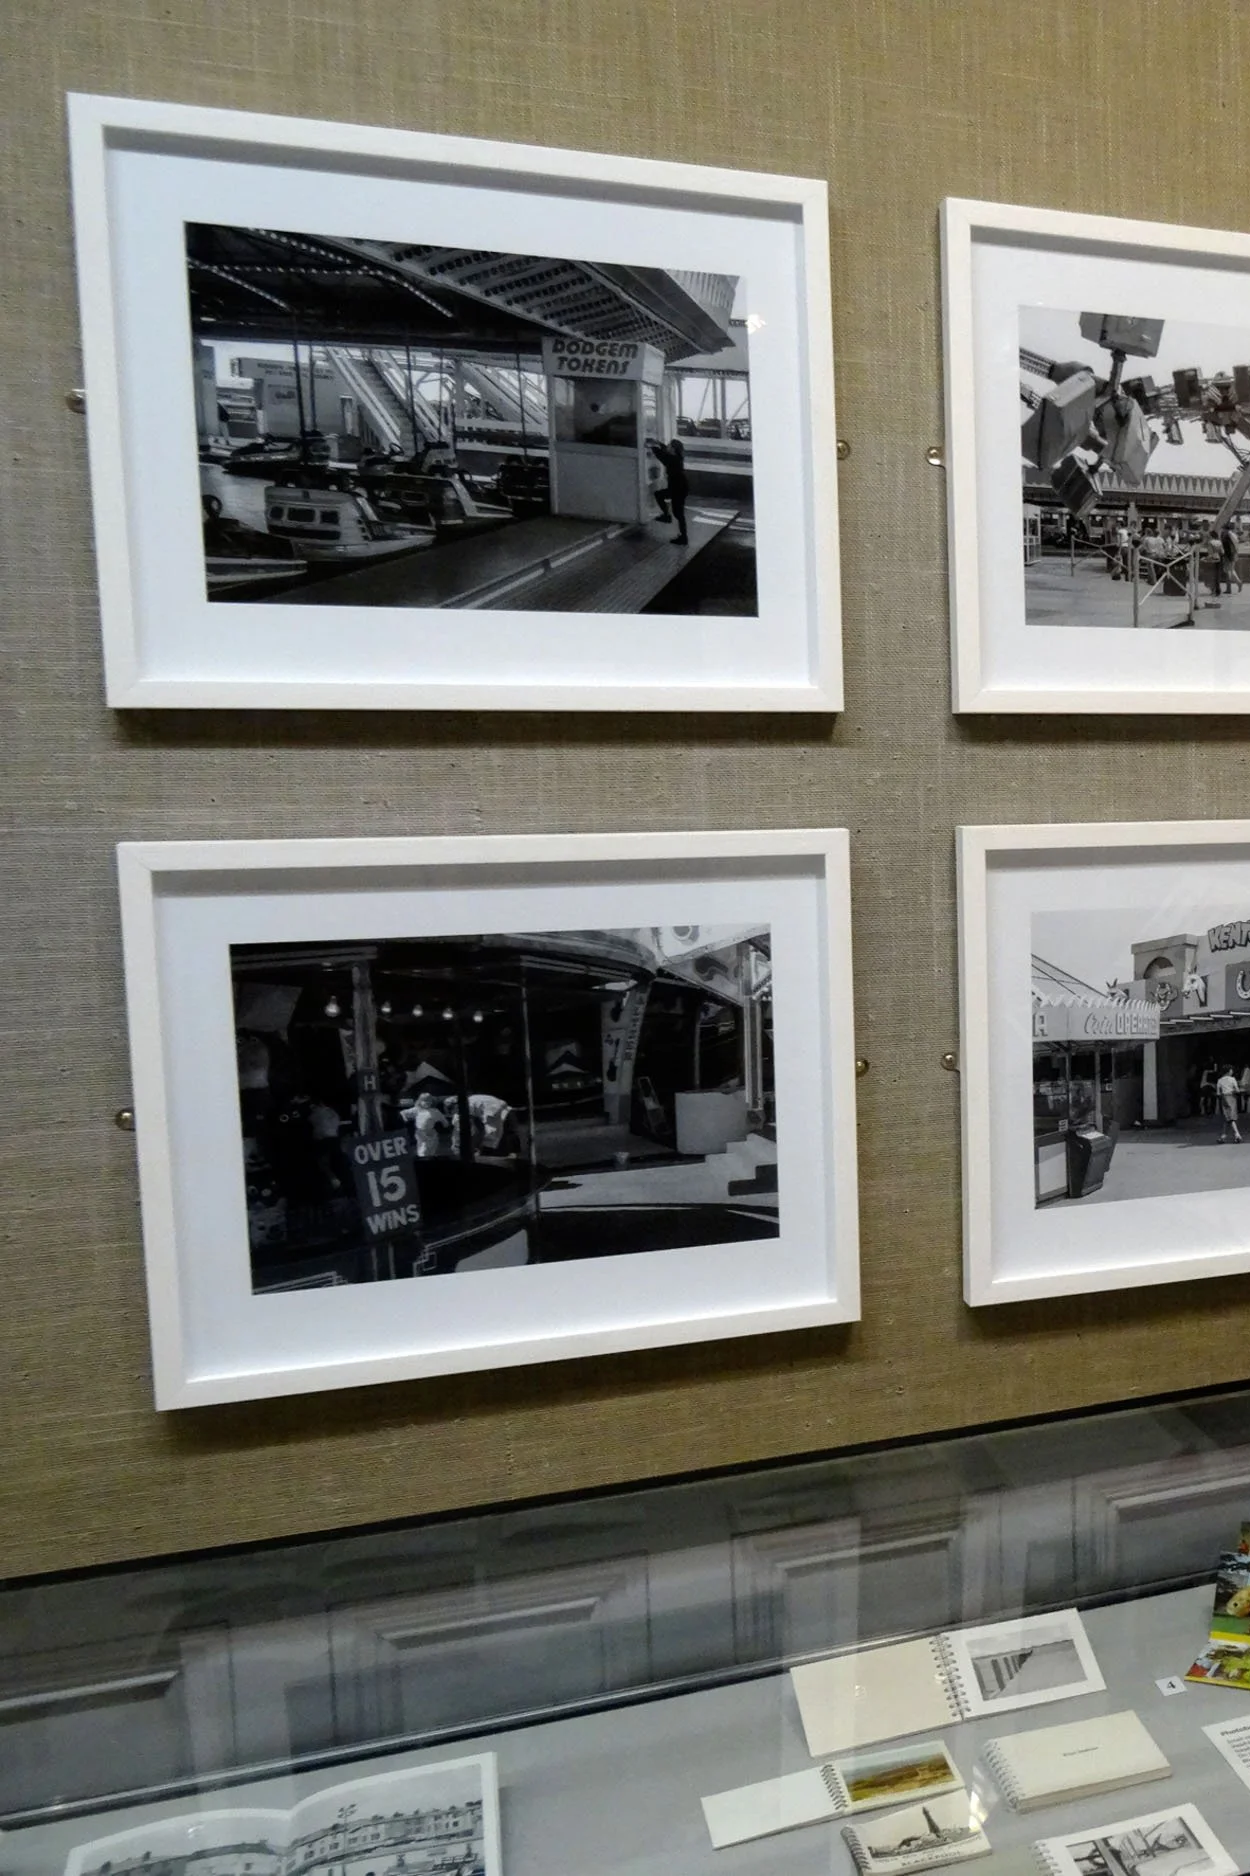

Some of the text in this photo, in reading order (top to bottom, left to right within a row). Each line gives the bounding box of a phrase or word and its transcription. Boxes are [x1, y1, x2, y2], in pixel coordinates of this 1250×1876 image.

[552, 339, 639, 359] DODGEM
[557, 356, 631, 375] TOKENS
[354, 1136, 409, 1165] OVER
[367, 1165, 407, 1208] 15
[366, 1203, 421, 1235] WINS
